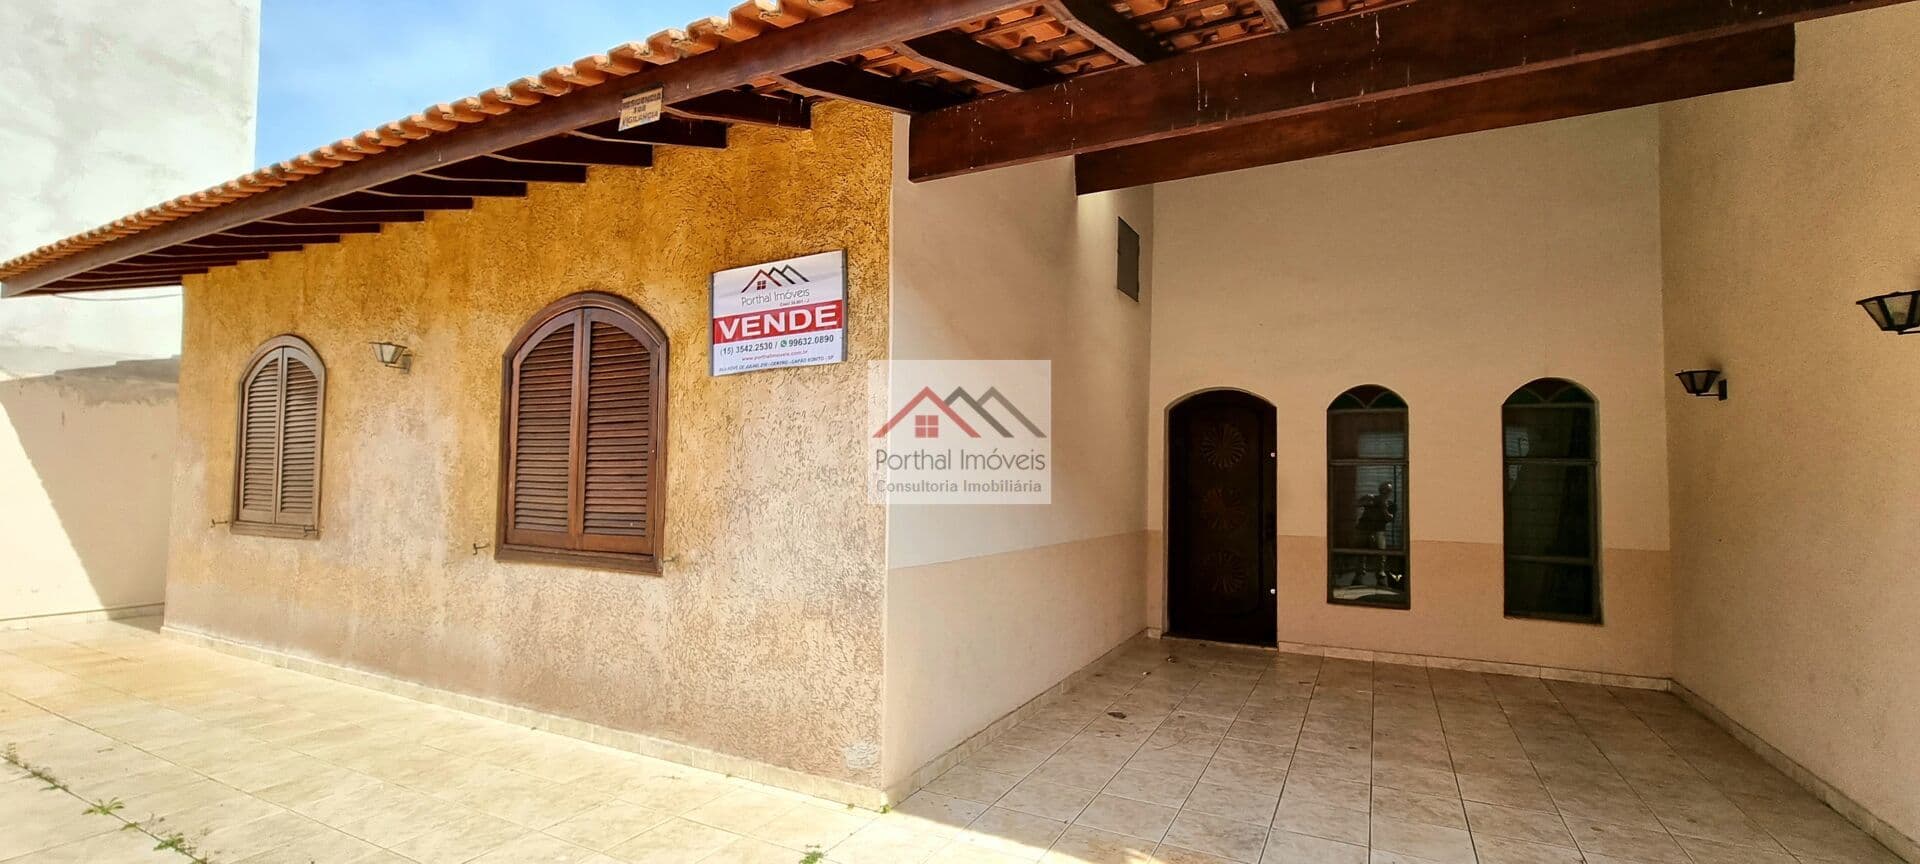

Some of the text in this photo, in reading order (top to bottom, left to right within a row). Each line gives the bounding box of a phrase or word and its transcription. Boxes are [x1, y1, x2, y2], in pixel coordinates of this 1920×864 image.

[741, 288, 810, 307] Porthal Imóveis
[718, 304, 838, 340] VENDE
[720, 346, 734, 357] (15)
[736, 341, 773, 354] 3542.2530
[788, 334, 835, 348] 99632.0890
